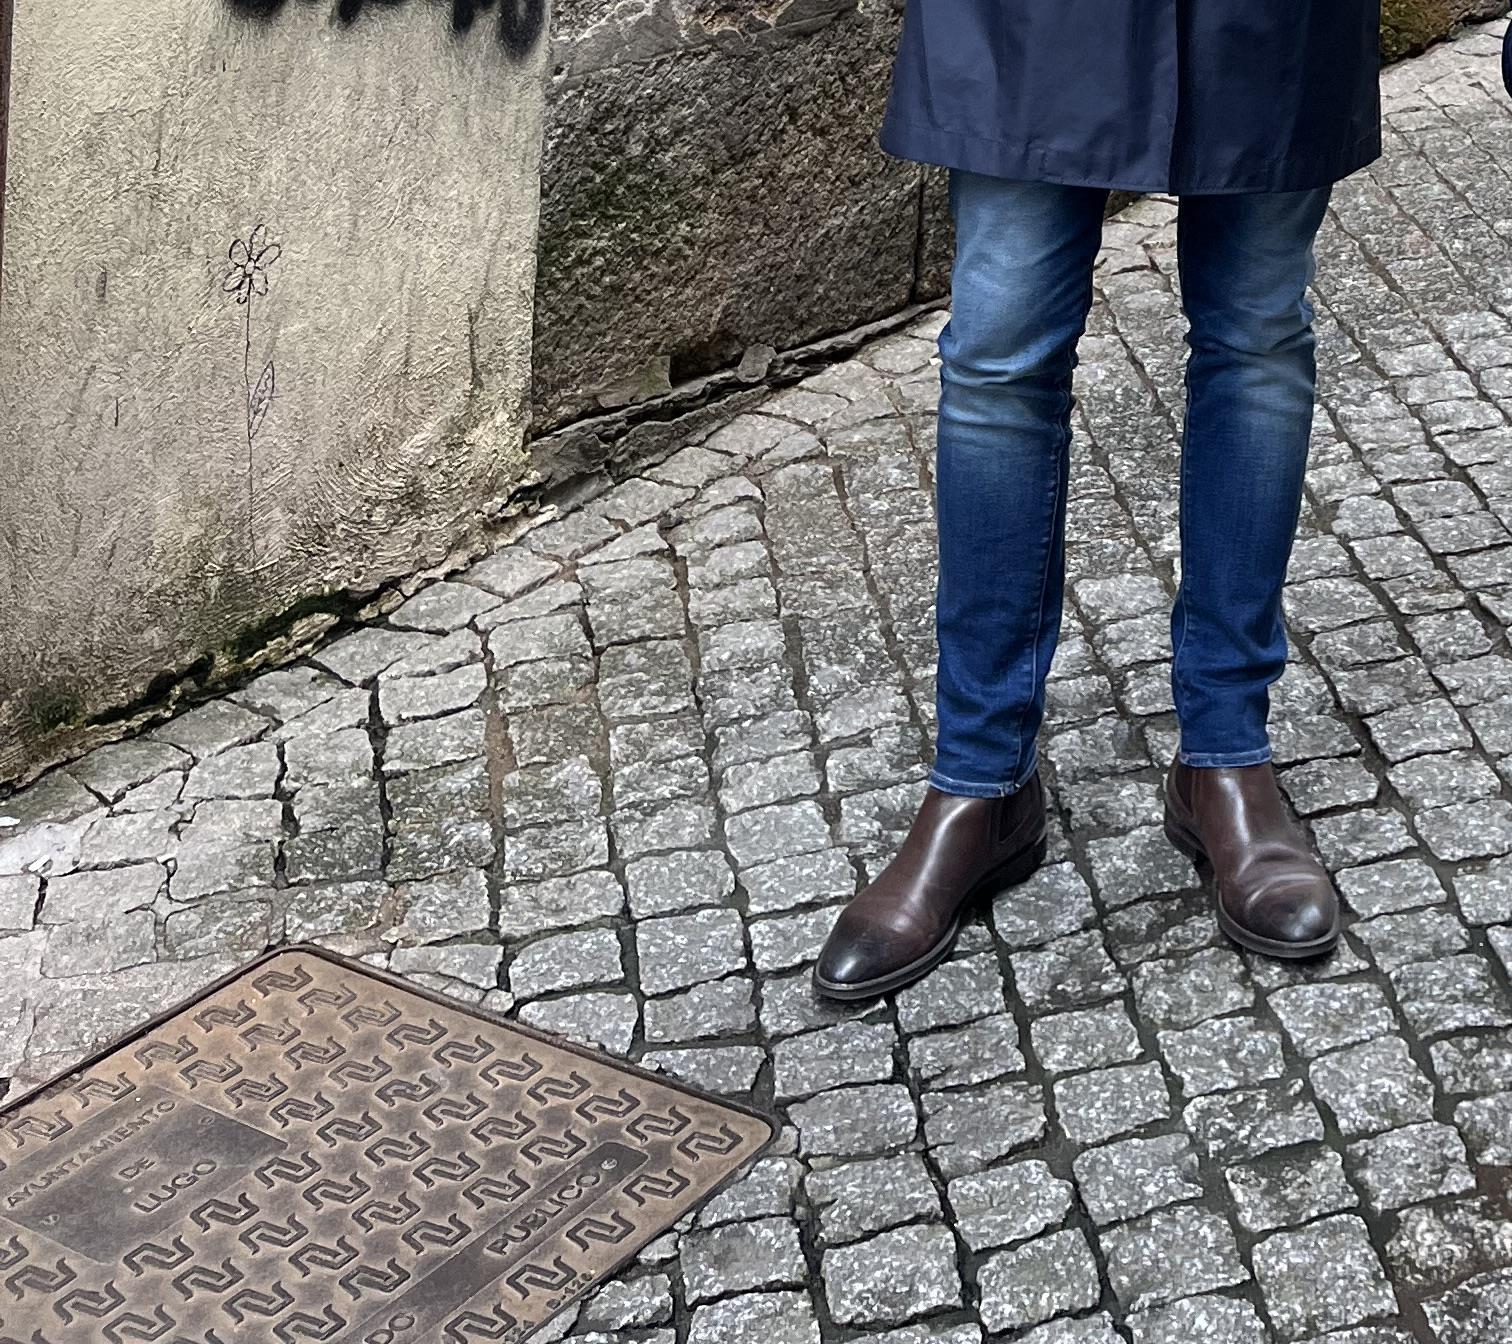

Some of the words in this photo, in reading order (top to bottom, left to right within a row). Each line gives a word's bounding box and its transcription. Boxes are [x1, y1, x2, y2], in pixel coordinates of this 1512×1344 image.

[7, 1100, 176, 1207] AYUNTAMIENTO
[118, 1157, 156, 1180] DE
[133, 1159, 217, 1213] LUGO
